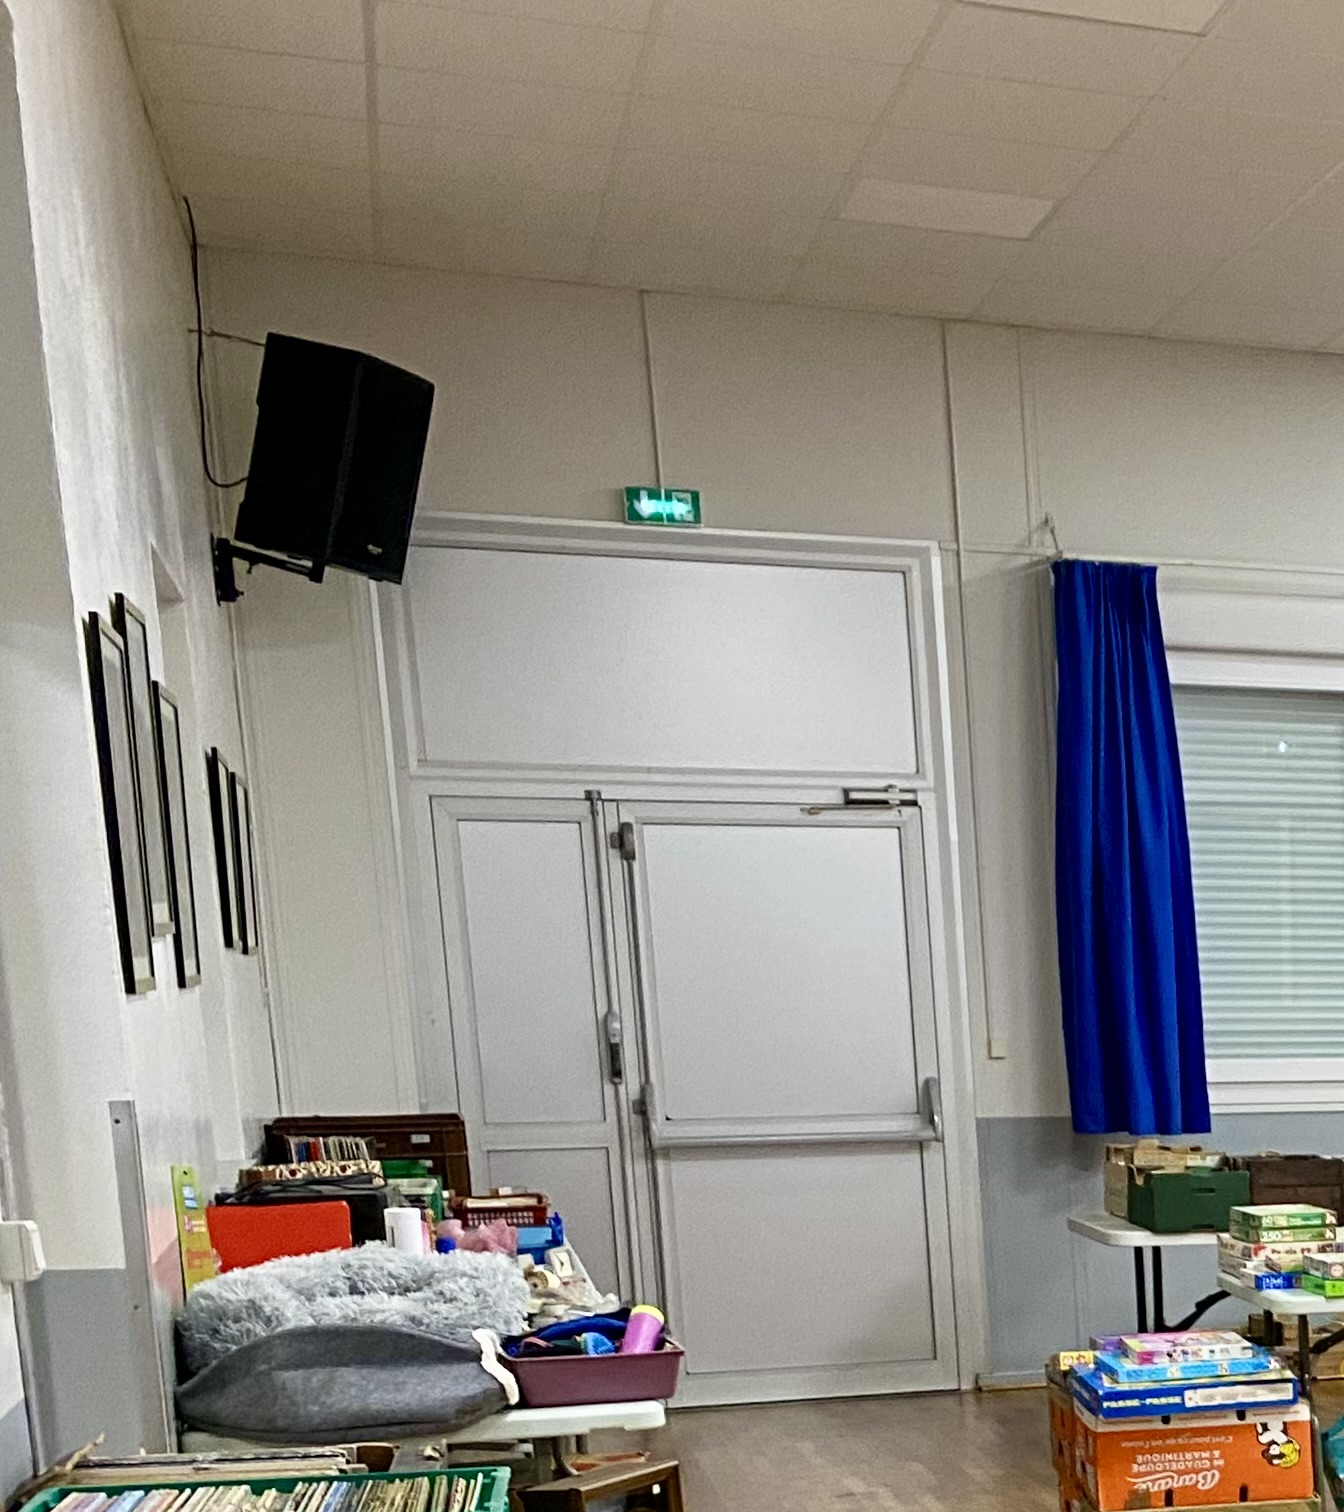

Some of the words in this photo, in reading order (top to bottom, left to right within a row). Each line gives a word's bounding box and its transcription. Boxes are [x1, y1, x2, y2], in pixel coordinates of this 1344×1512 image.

[1102, 1396, 1183, 1409] PASSE-PASSE
[1135, 1450, 1210, 1461] MARTINIQUE
[1131, 1459, 1211, 1472] GUADELOUPE
[1126, 1470, 1220, 1493] Banane
